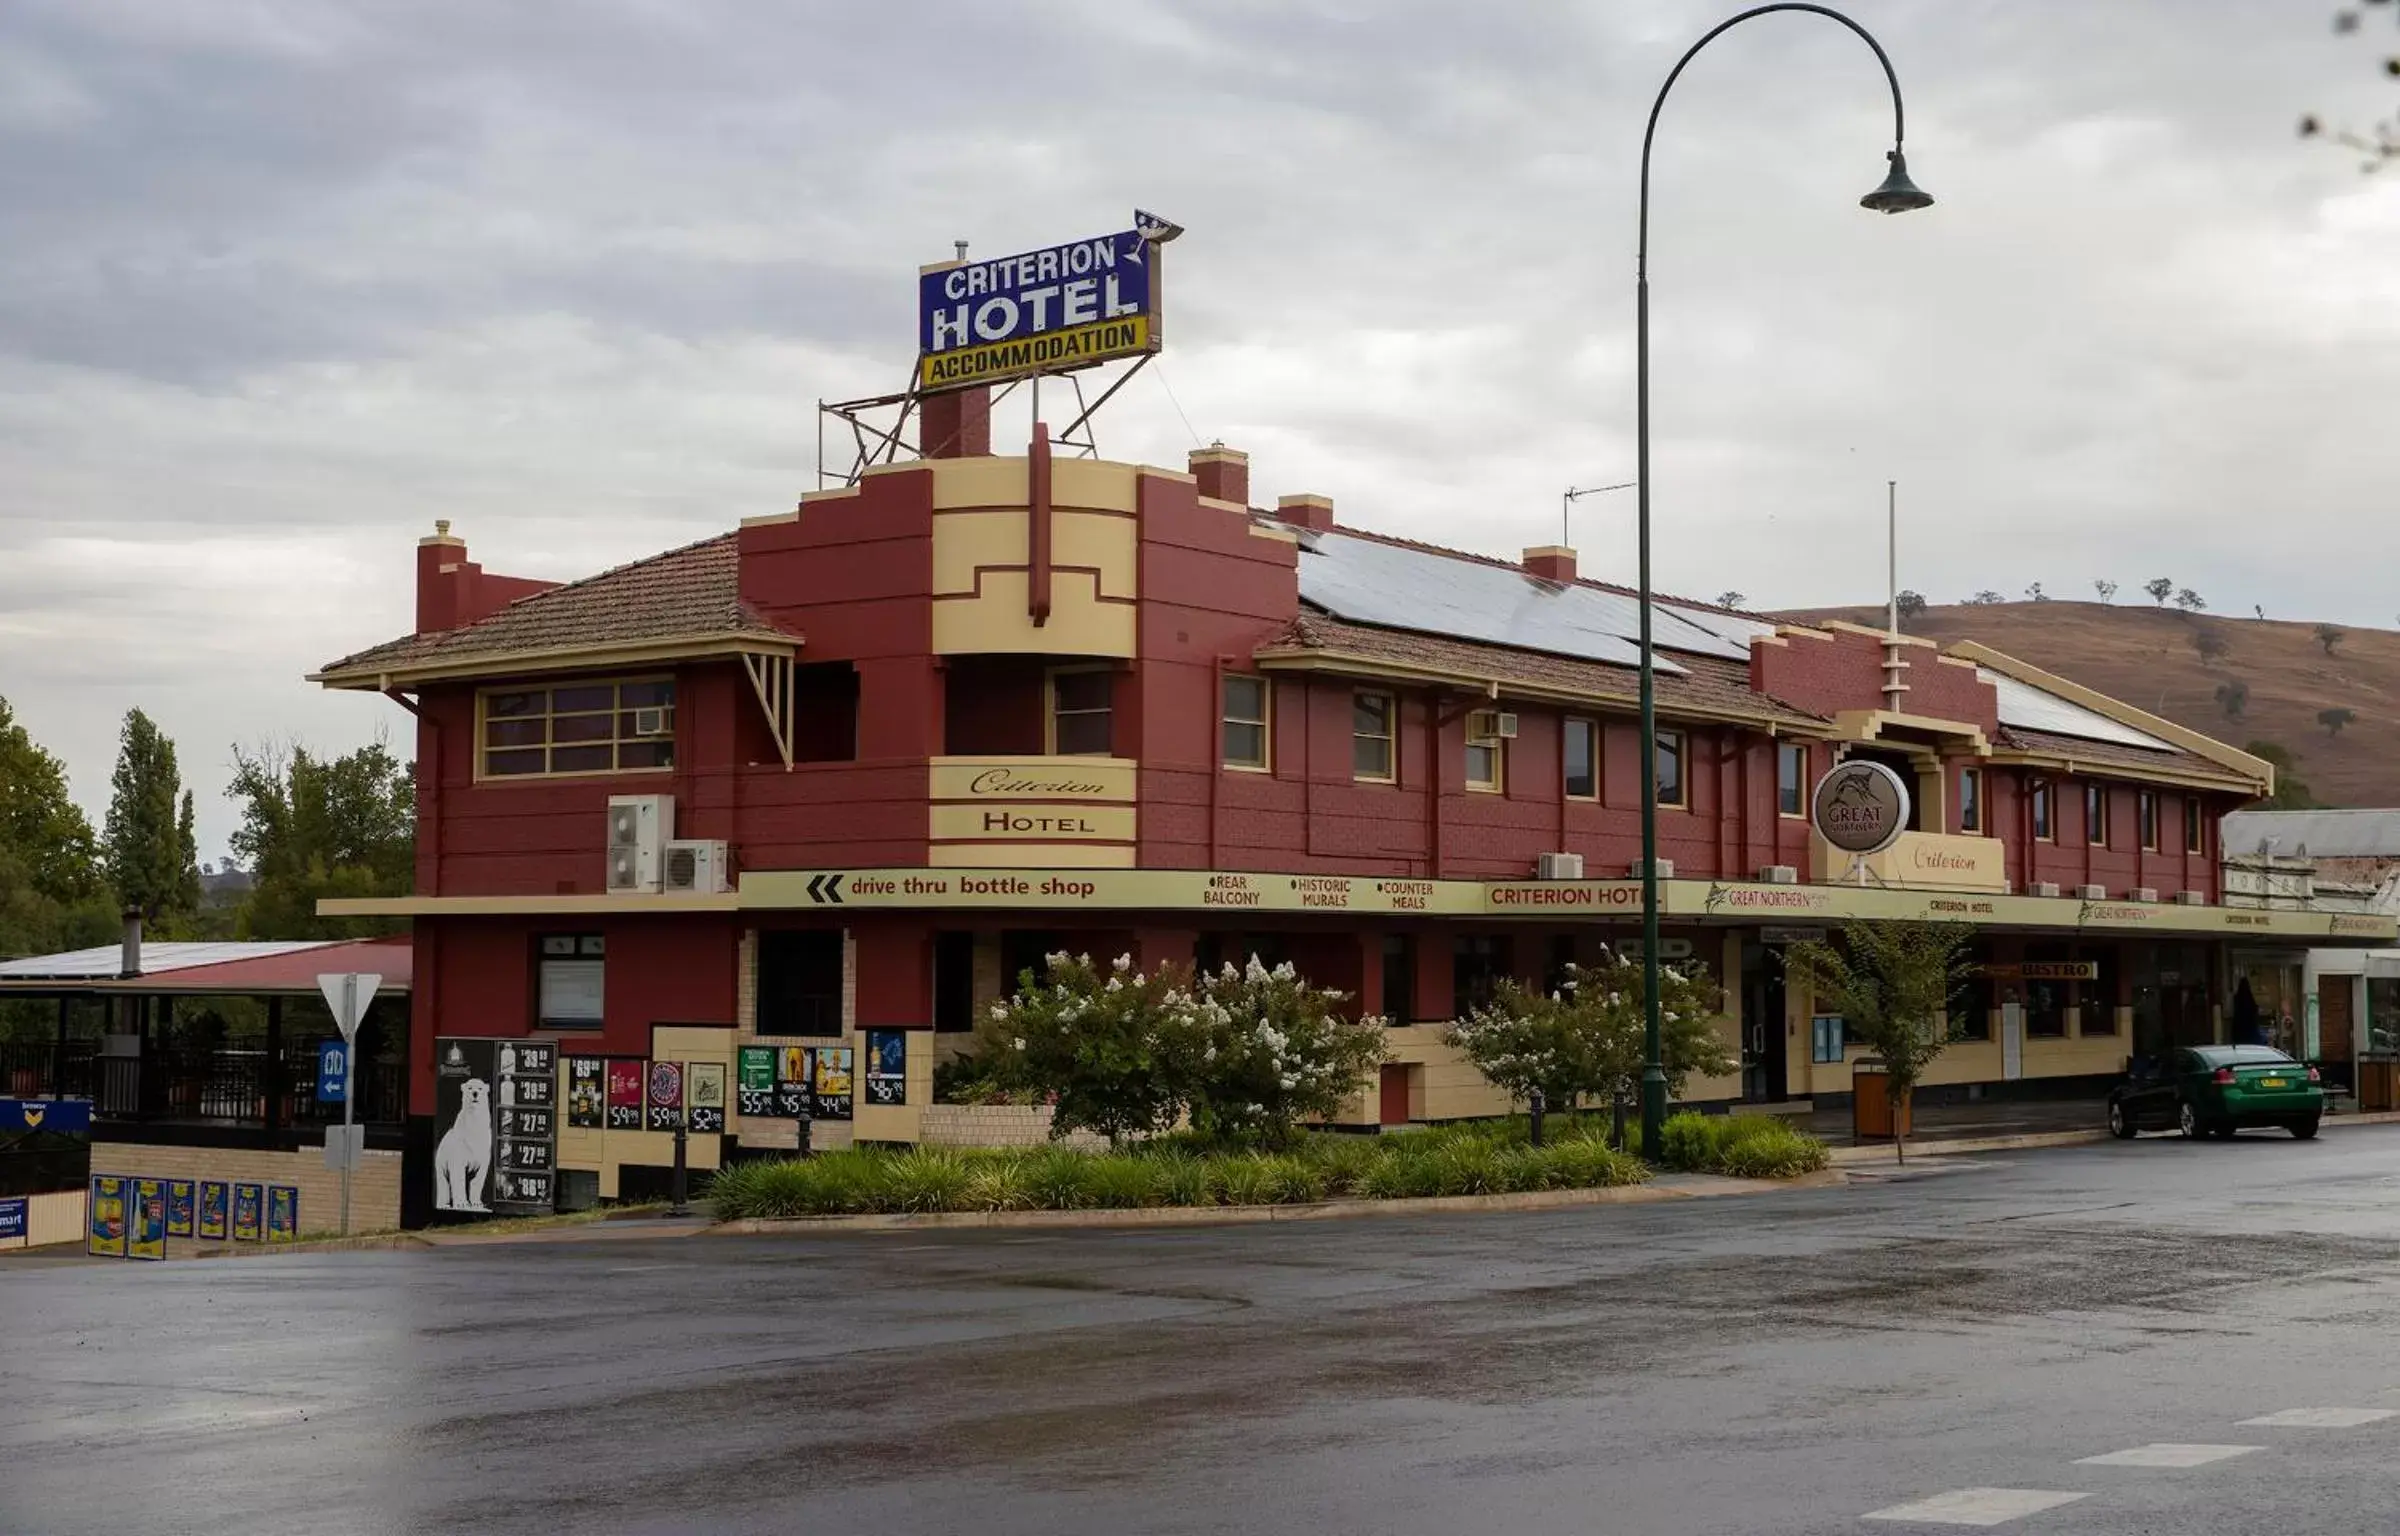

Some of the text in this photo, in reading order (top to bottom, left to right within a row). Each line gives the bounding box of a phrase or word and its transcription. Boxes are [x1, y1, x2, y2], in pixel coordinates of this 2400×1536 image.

[945, 238, 1115, 300] CRITERION
[932, 273, 1138, 351] HOTEL
[930, 324, 1136, 381] ACCOMMODATION
[971, 768, 1104, 795] Criterion
[1828, 806, 1883, 822] GREAT
[983, 812, 1096, 833] HOTEL
[1913, 843, 1976, 871] Criterion
[851, 877, 1095, 898] drive thru bottle shop
[1216, 876, 1247, 890] REAR
[1298, 879, 1351, 893] HISTORIC
[1383, 883, 1433, 896] COUNTER
[1204, 891, 1260, 906] BALCONY
[1303, 894, 1348, 908] MURALS
[1392, 896, 1425, 909] MEALS
[1491, 888, 1663, 905] CRITERION HOT
[1729, 891, 1759, 906] GREAT
[1759, 891, 1810, 907] NORTHERN
[2021, 964, 2089, 977] BISTRO
